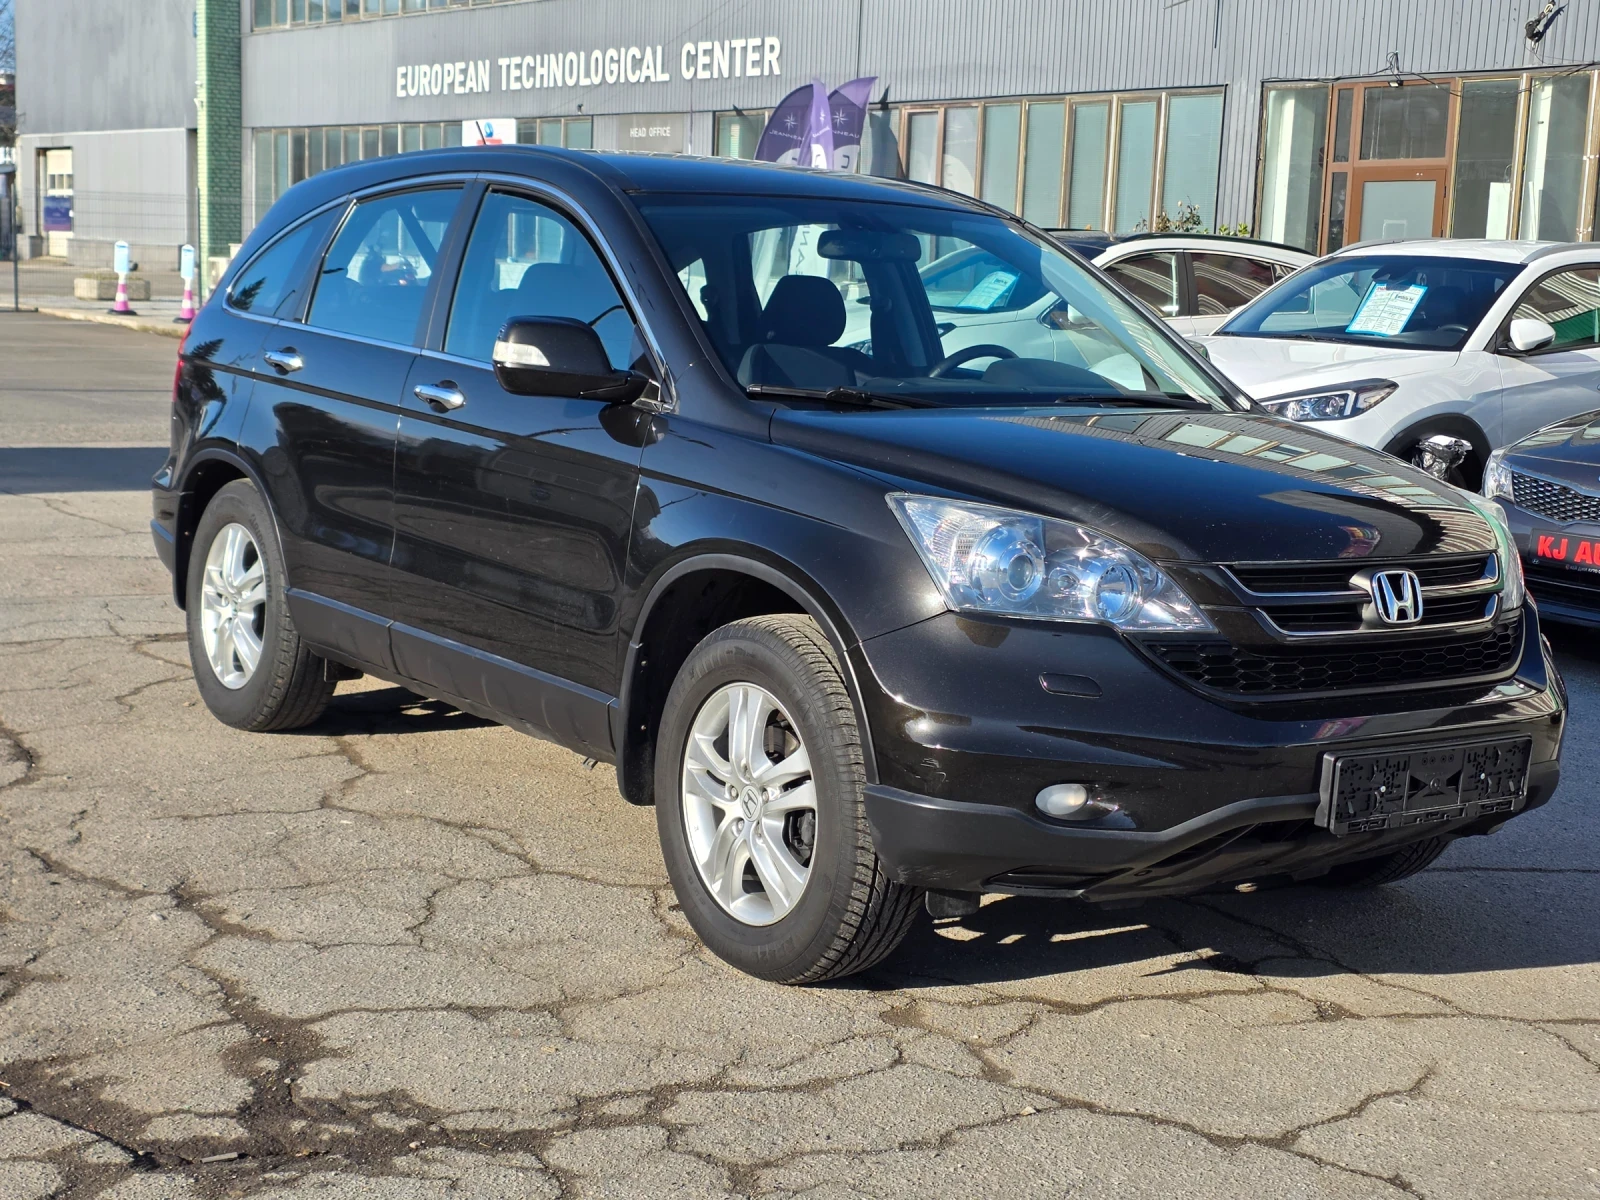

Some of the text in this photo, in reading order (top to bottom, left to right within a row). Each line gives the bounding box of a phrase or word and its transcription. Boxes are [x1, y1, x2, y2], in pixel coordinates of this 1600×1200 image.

[396, 36, 781, 98] EUROPEAN TECHNOLOGICAL CENTER
[630, 126, 671, 138] HEAD OFFICE
[832, 129, 860, 139] NNEAU
[1537, 535, 1569, 560] KJ
